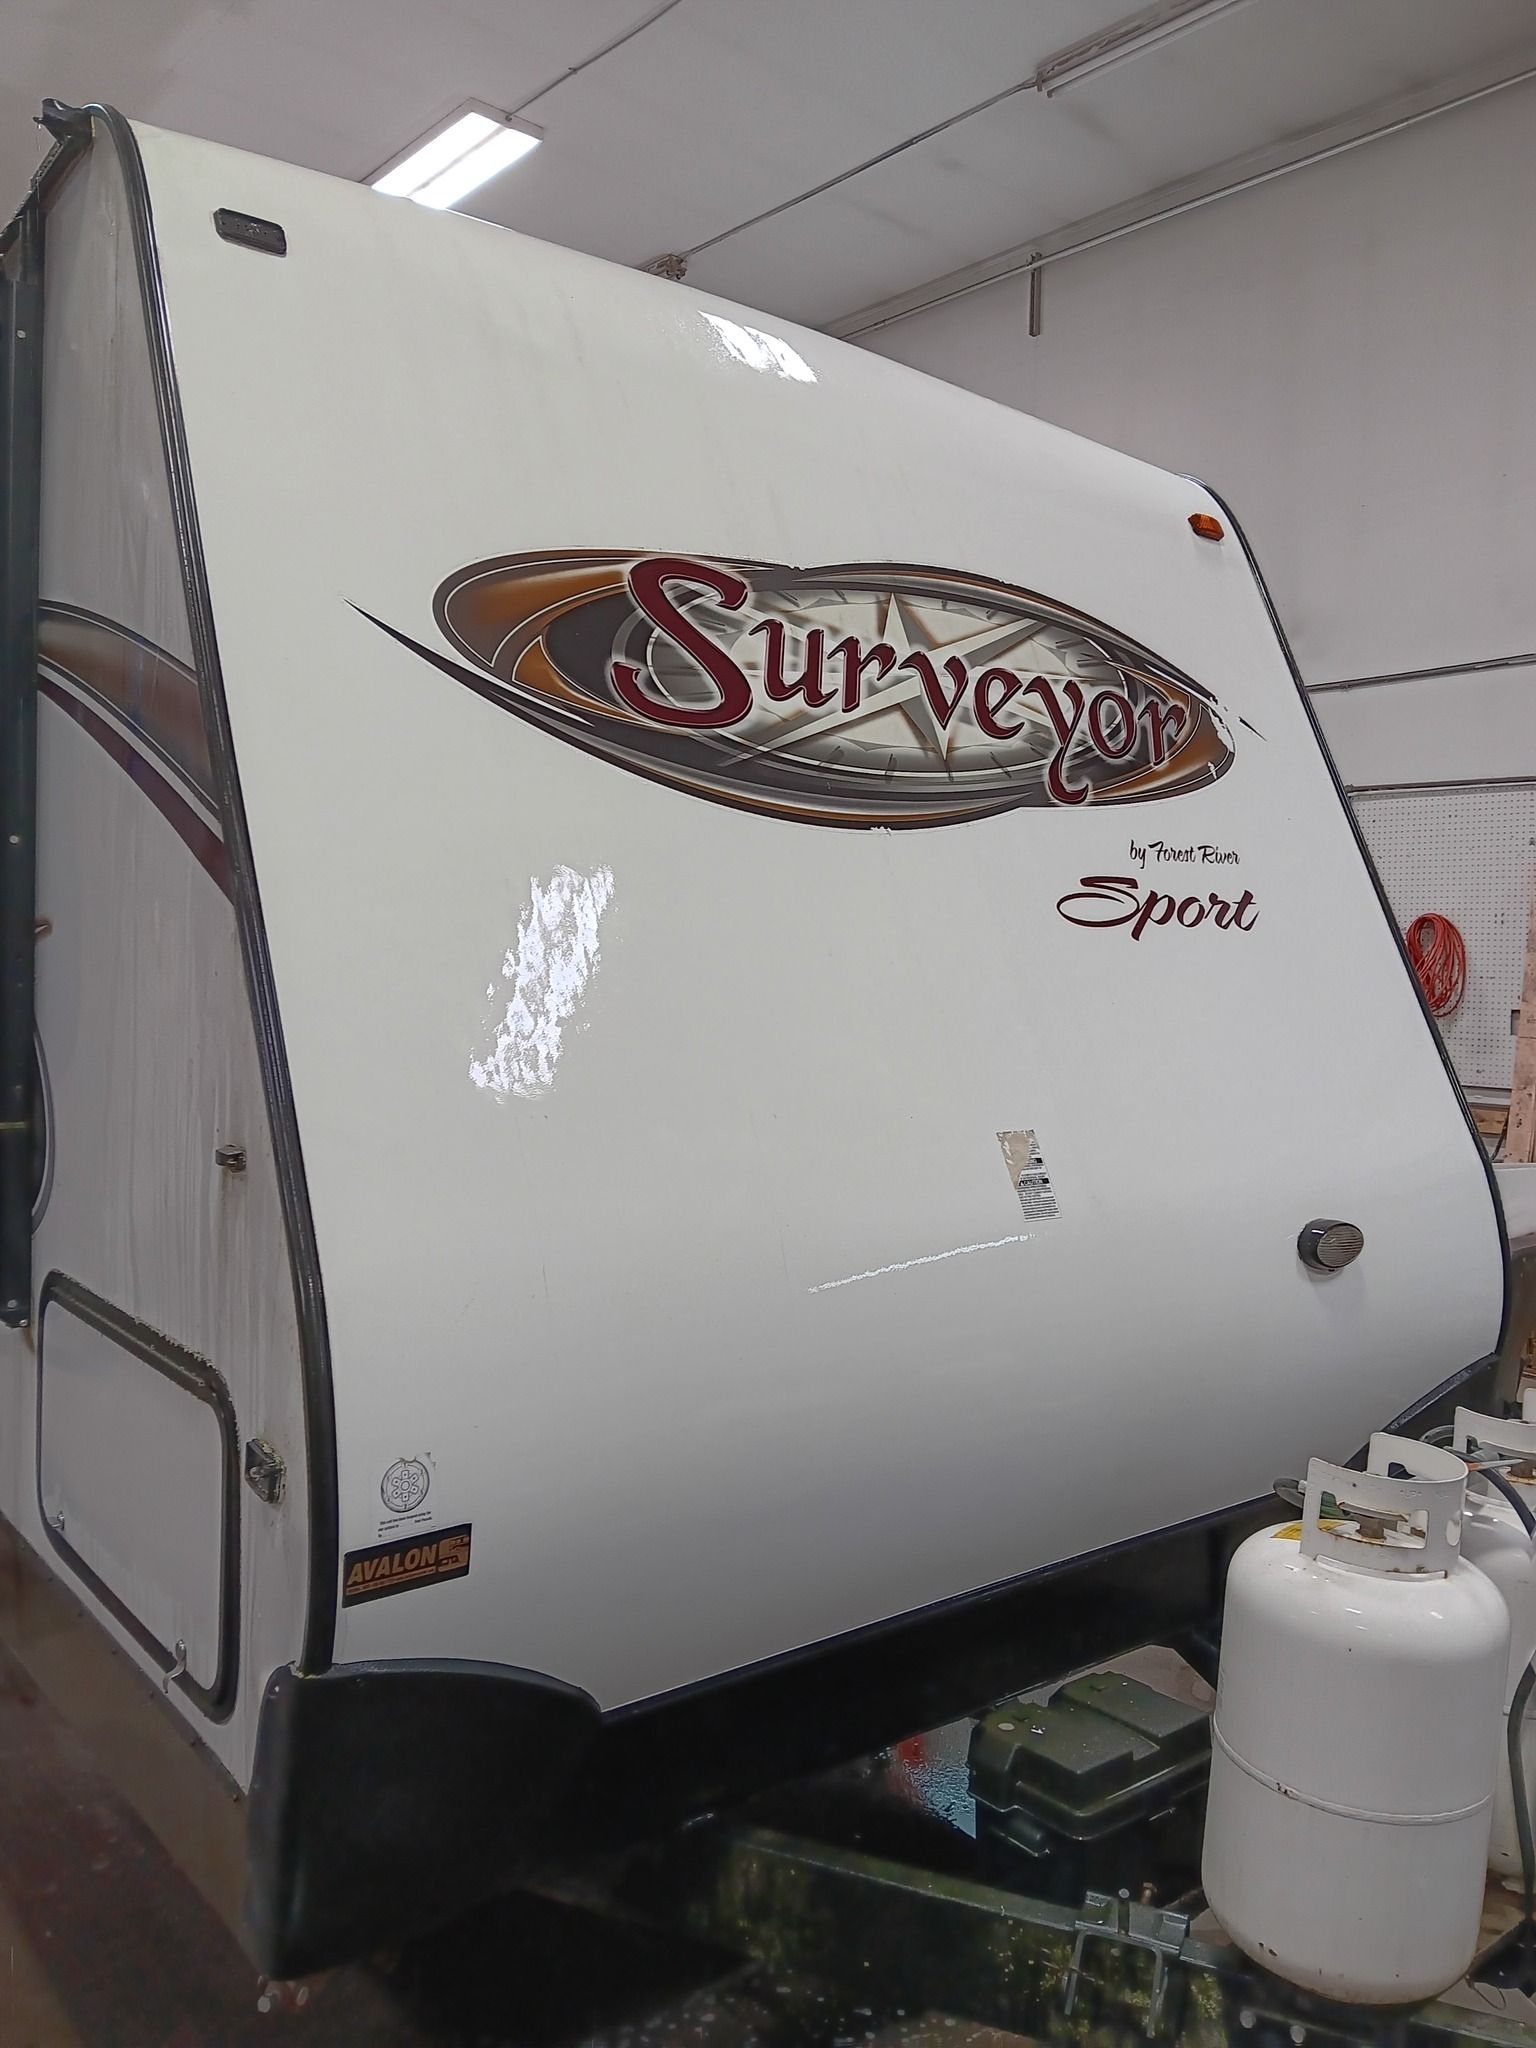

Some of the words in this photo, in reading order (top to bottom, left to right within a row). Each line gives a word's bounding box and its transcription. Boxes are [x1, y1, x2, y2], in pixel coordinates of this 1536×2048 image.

[611, 556, 1188, 806] Surveyor
[1129, 839, 1146, 869] by
[1148, 841, 1197, 863] Forest
[1198, 844, 1241, 865] River
[1056, 875, 1261, 942] Sport
[346, 1543, 438, 1586] AVALON
